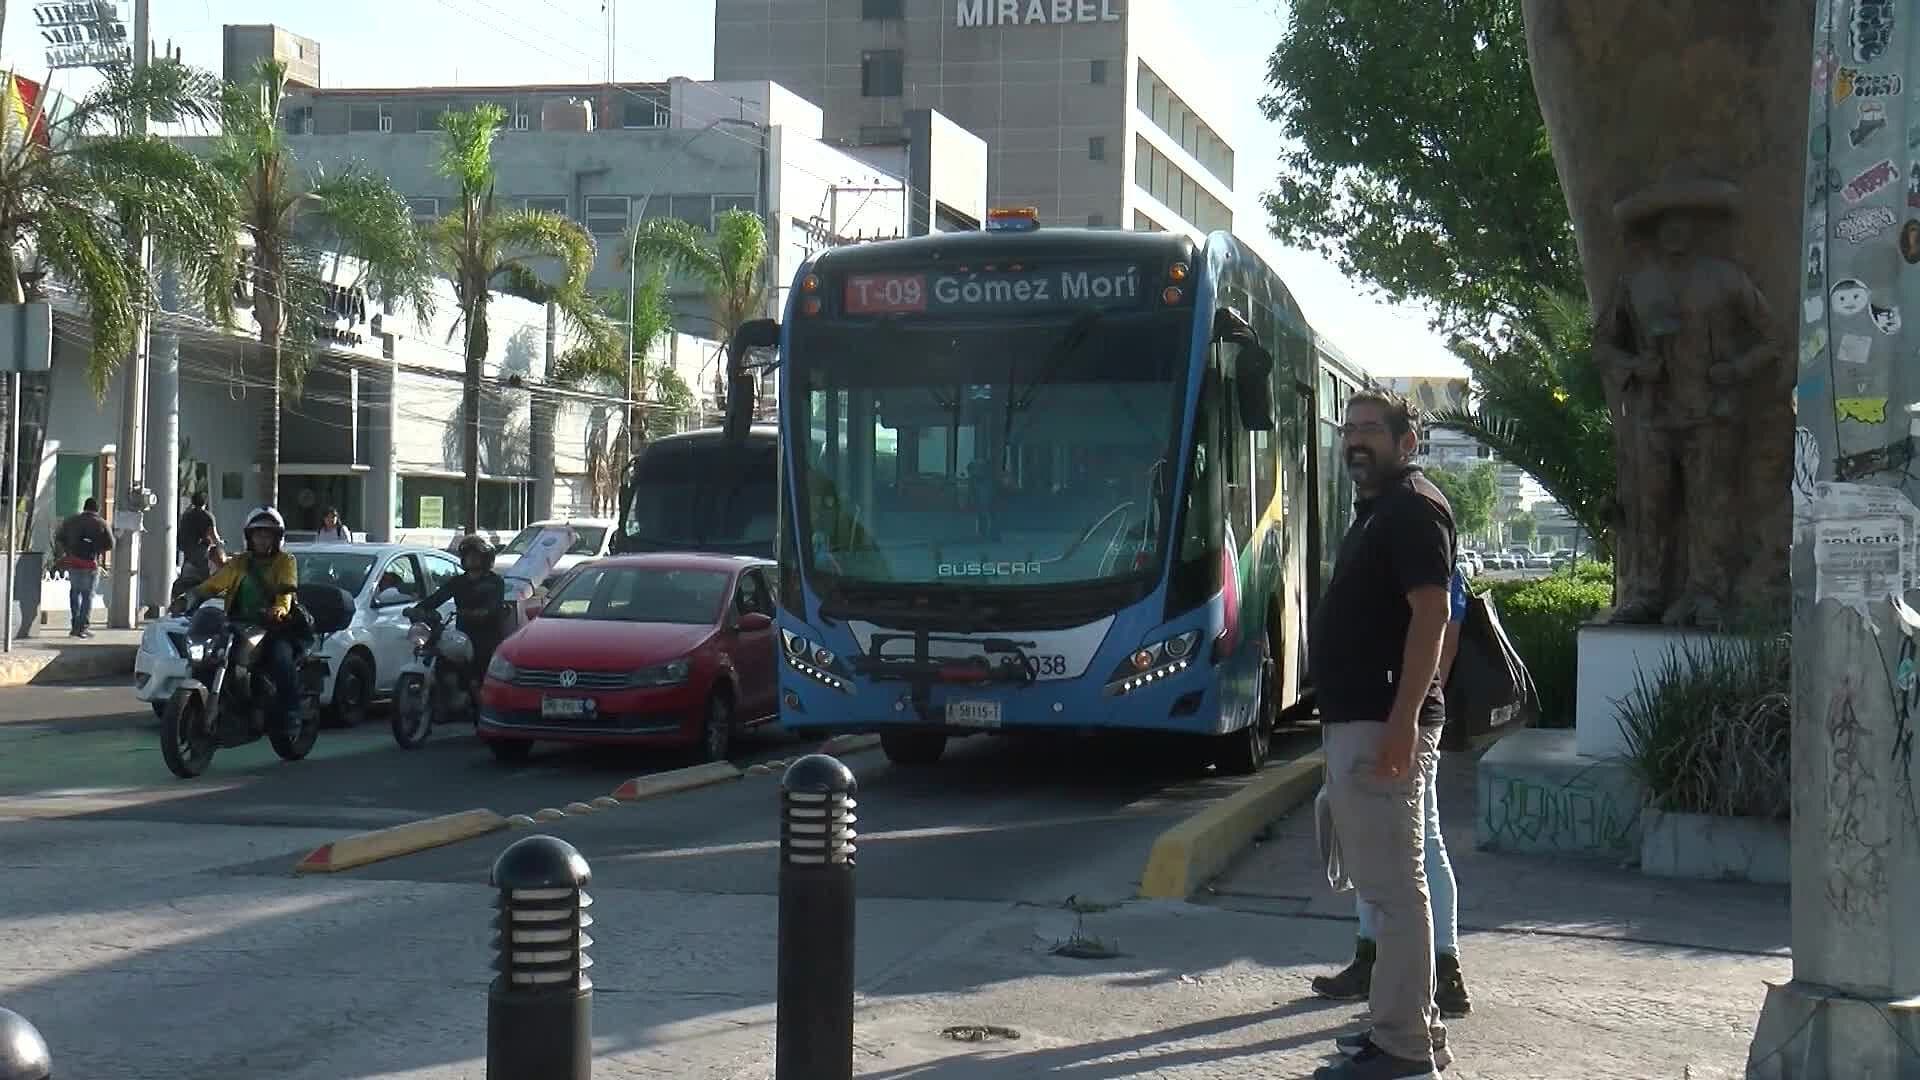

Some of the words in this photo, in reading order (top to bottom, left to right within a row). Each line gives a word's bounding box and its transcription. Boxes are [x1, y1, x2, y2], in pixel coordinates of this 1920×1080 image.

[956, 0, 1120, 27] MIRABEL
[855, 278, 922, 305] T-09
[934, 274, 1049, 303] Gómez
